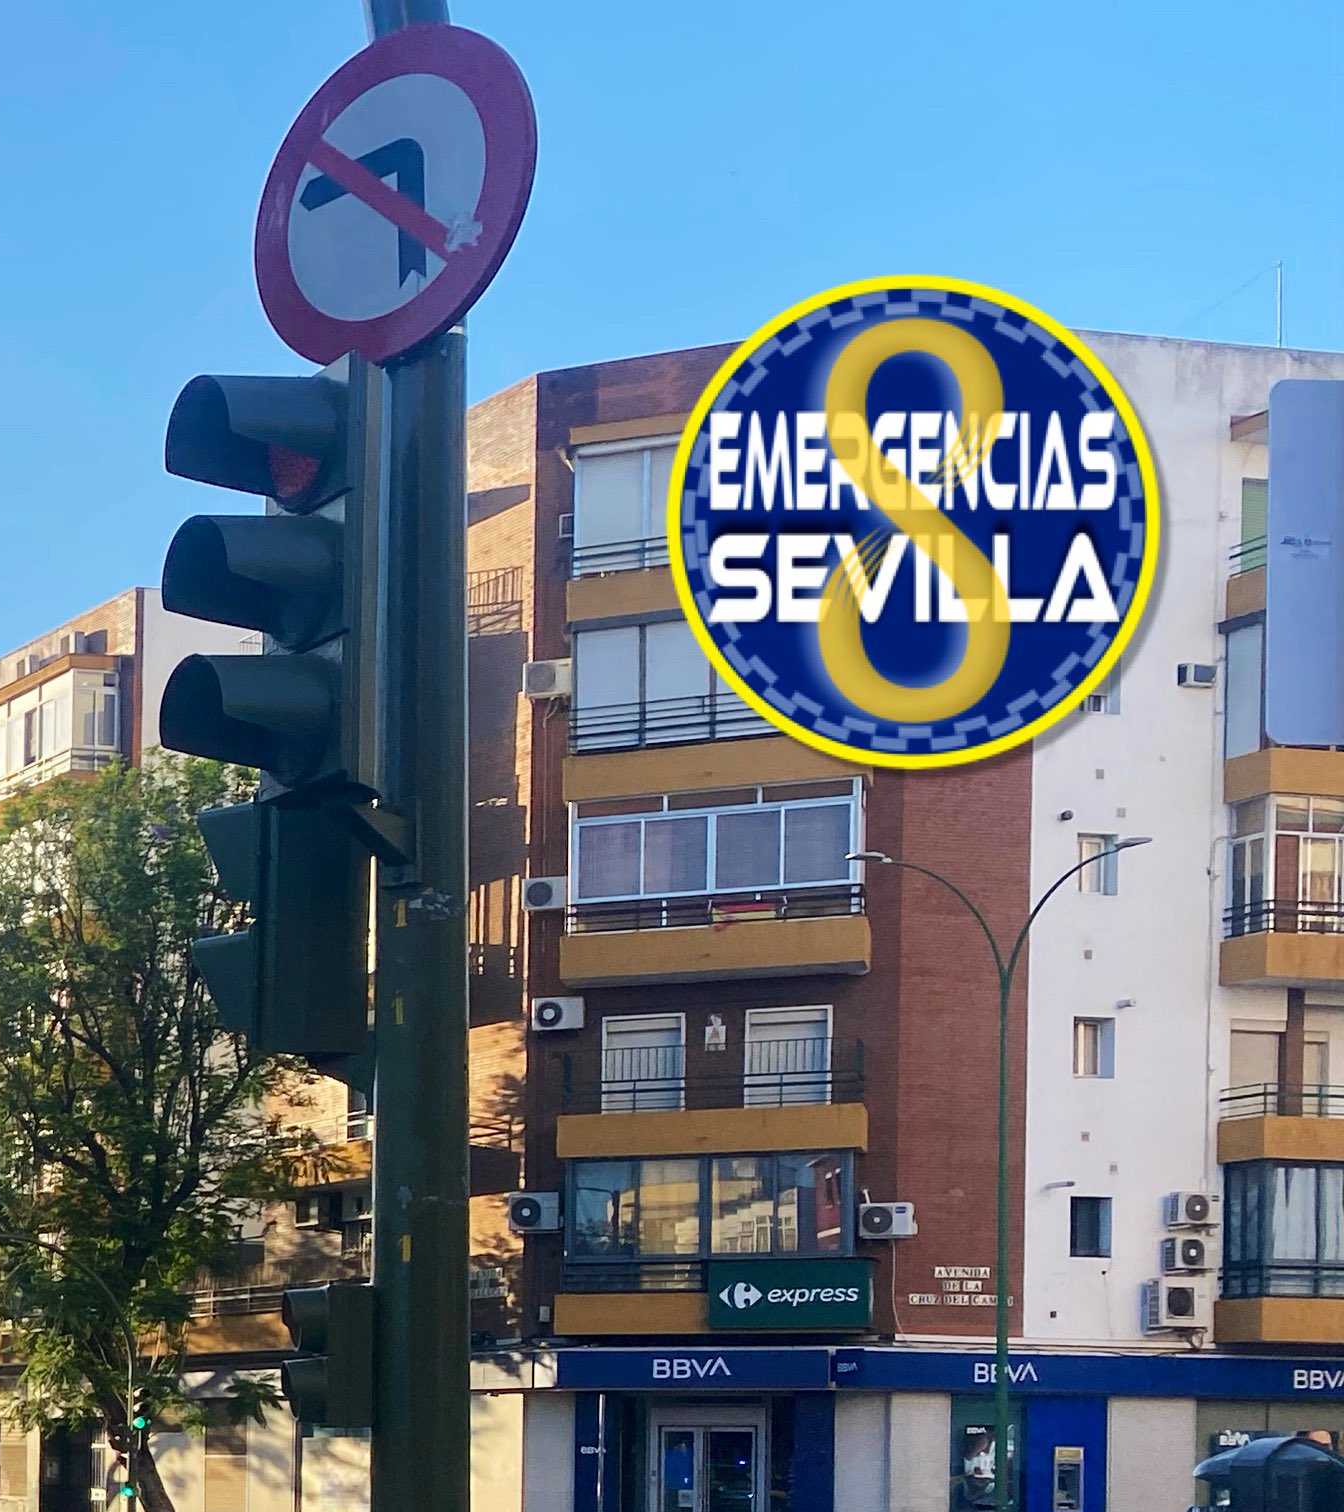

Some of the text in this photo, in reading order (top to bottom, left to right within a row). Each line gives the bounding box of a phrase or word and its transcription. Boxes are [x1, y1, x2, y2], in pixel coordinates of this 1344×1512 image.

[935, 1267, 990, 1277] AVENIDA
[943, 1281, 980, 1291] DE LA
[767, 1287, 860, 1307] express
[909, 1295, 1014, 1306] CRUZ DEL CAMO
[652, 1356, 731, 1380] BBVA
[837, 1362, 858, 1373] BBVA
